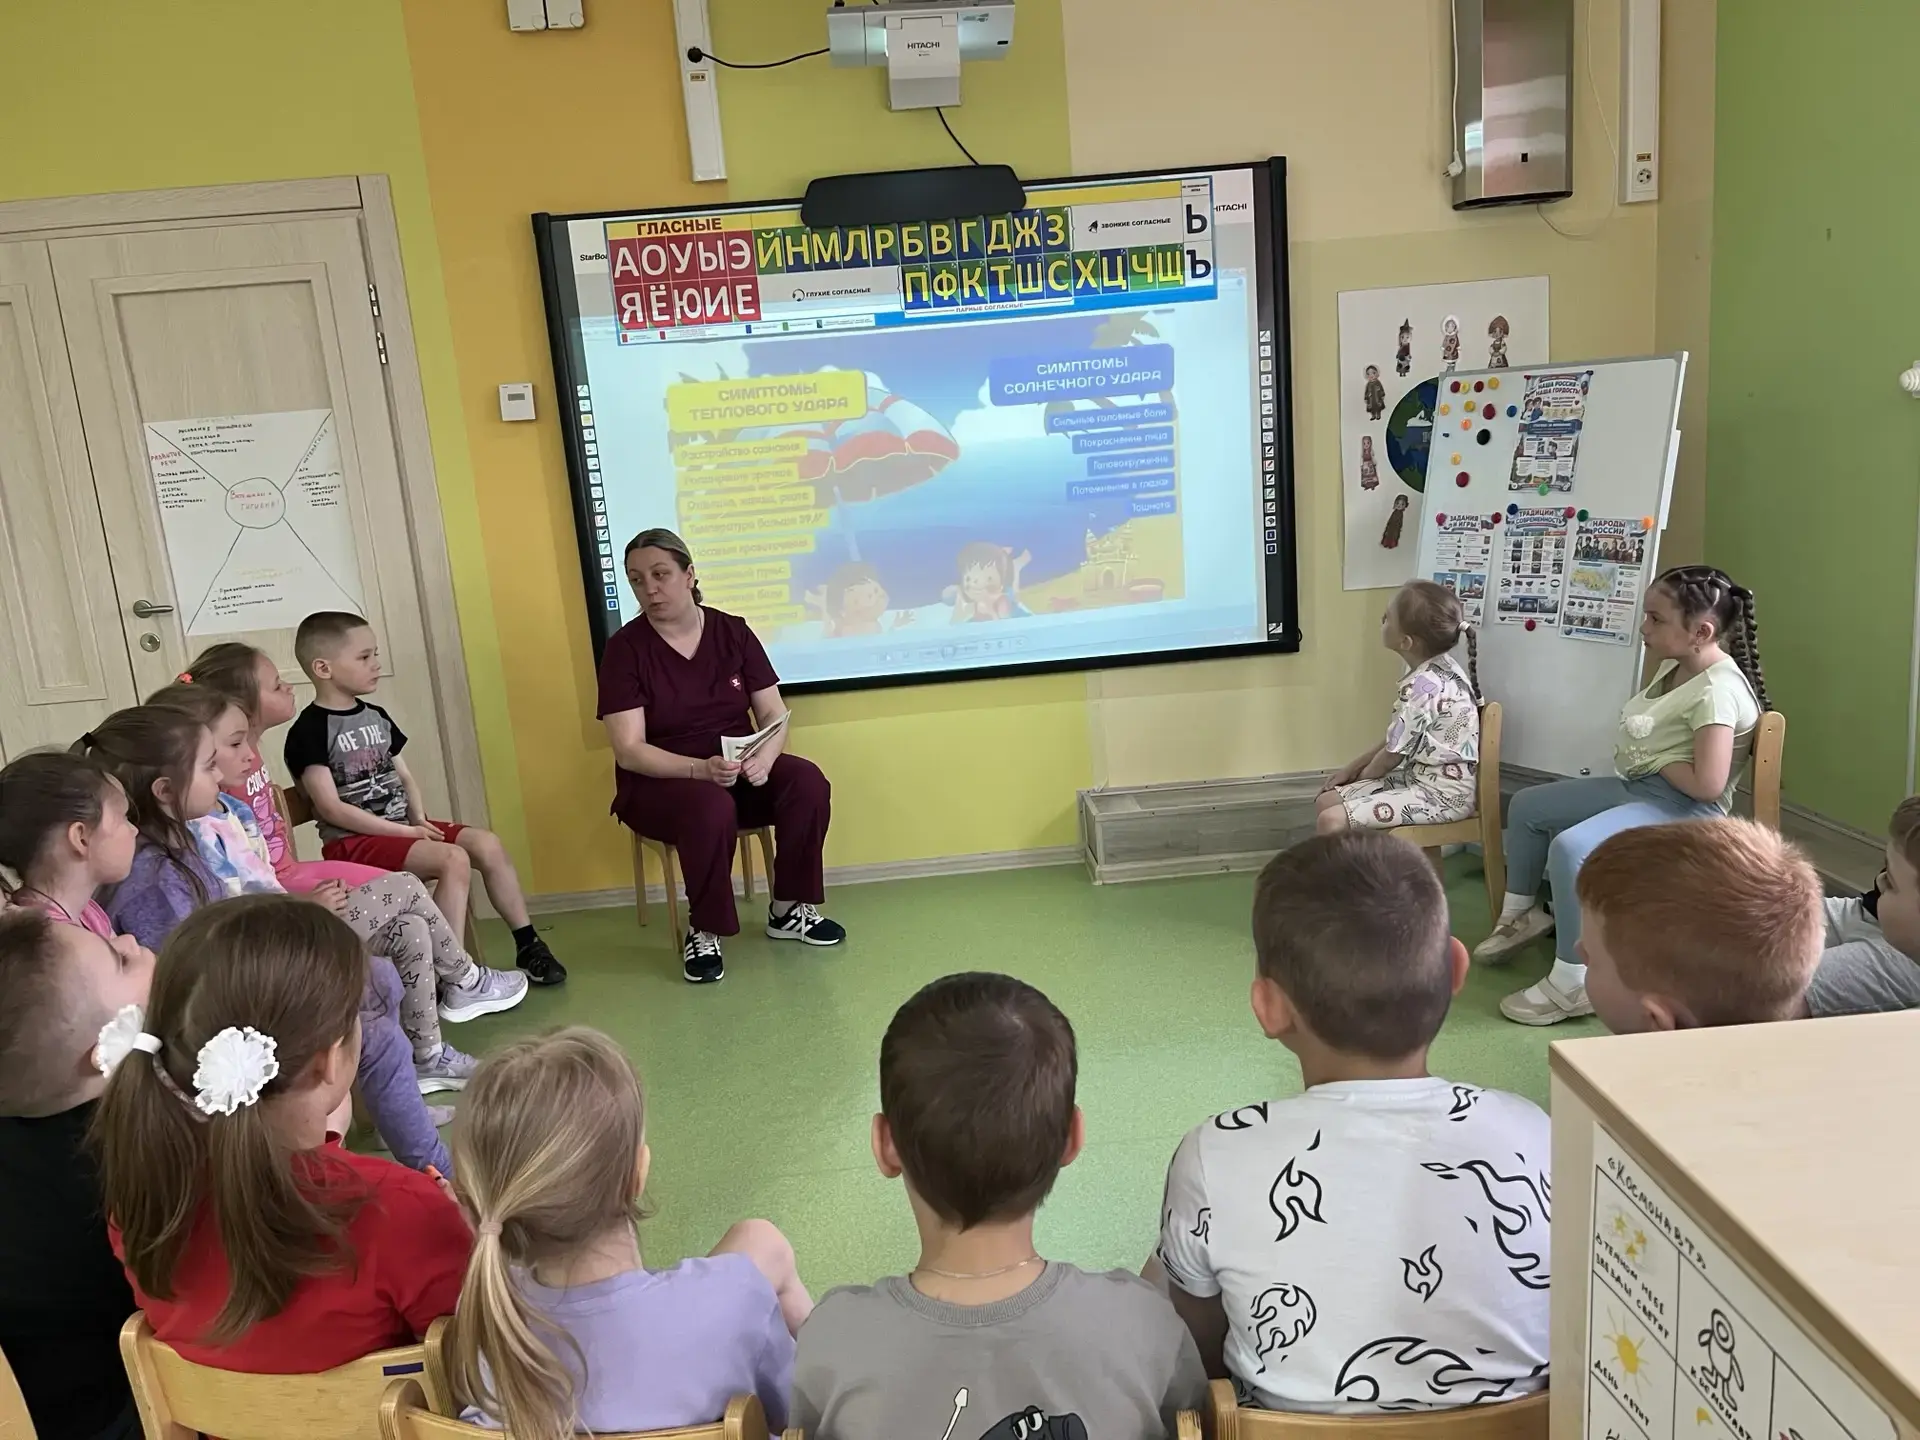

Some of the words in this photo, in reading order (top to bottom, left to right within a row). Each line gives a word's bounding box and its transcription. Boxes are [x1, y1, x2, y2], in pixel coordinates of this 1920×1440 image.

[907, 41, 940, 49] HITACHI
[636, 218, 723, 236] ГЛАСНЫЕ
[1131, 218, 1171, 226] СОГЛАСНЫЕ
[1036, 356, 1129, 376] СИМПТОМЫ
[718, 382, 818, 401] СИМПТОМЫ
[1003, 374, 1107, 395] СОЛНЕЧНОГО
[1110, 370, 1162, 386] УДАРА
[690, 402, 789, 421] ТЕПЛОВОГО
[793, 396, 848, 412] УДАРА
[1052, 415, 1096, 427] Сильные
[1097, 409, 1142, 423] головные
[1143, 408, 1168, 417] боли
[1079, 435, 1143, 449] Покраснение
[1144, 431, 1168, 442] лица
[1093, 456, 1169, 472] Головокружение
[1072, 484, 1130, 496] Потемнение
[1131, 500, 1171, 513] Тошнота
[1593, 520, 1626, 528] НАРОДЫ
[1593, 527, 1625, 535] РОССИИ
[337, 730, 360, 753] BE
[358, 724, 387, 746] THE
[1641, 1282, 1664, 1316] НЕБЕ
[1594, 1359, 1619, 1390] ДЕНЬ
